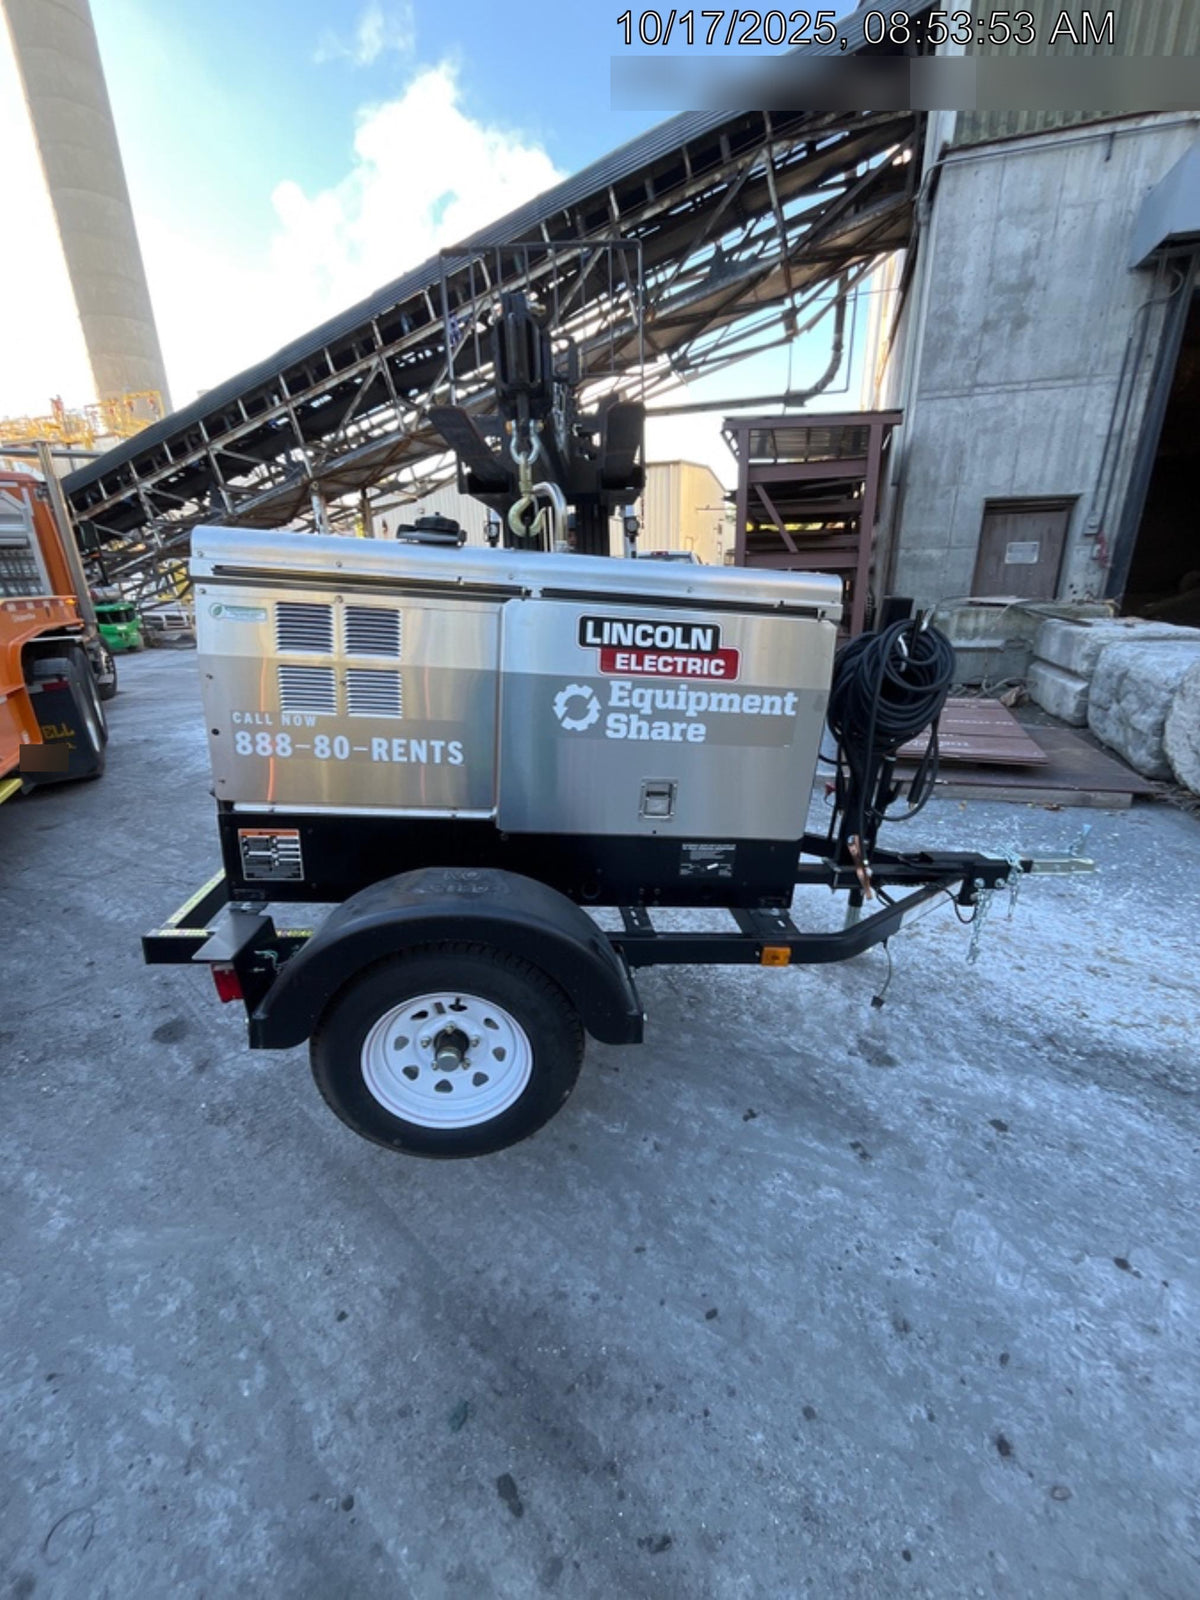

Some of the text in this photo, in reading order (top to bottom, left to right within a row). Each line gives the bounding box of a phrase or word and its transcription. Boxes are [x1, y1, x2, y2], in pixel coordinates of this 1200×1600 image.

[585, 620, 714, 651] LINCOLN
[615, 653, 726, 676] ELECTRIC
[608, 680, 798, 717] Equipment
[232, 711, 317, 728] CALL NOW
[605, 713, 707, 742] Share
[235, 730, 464, 766] 888-80-RENTS
